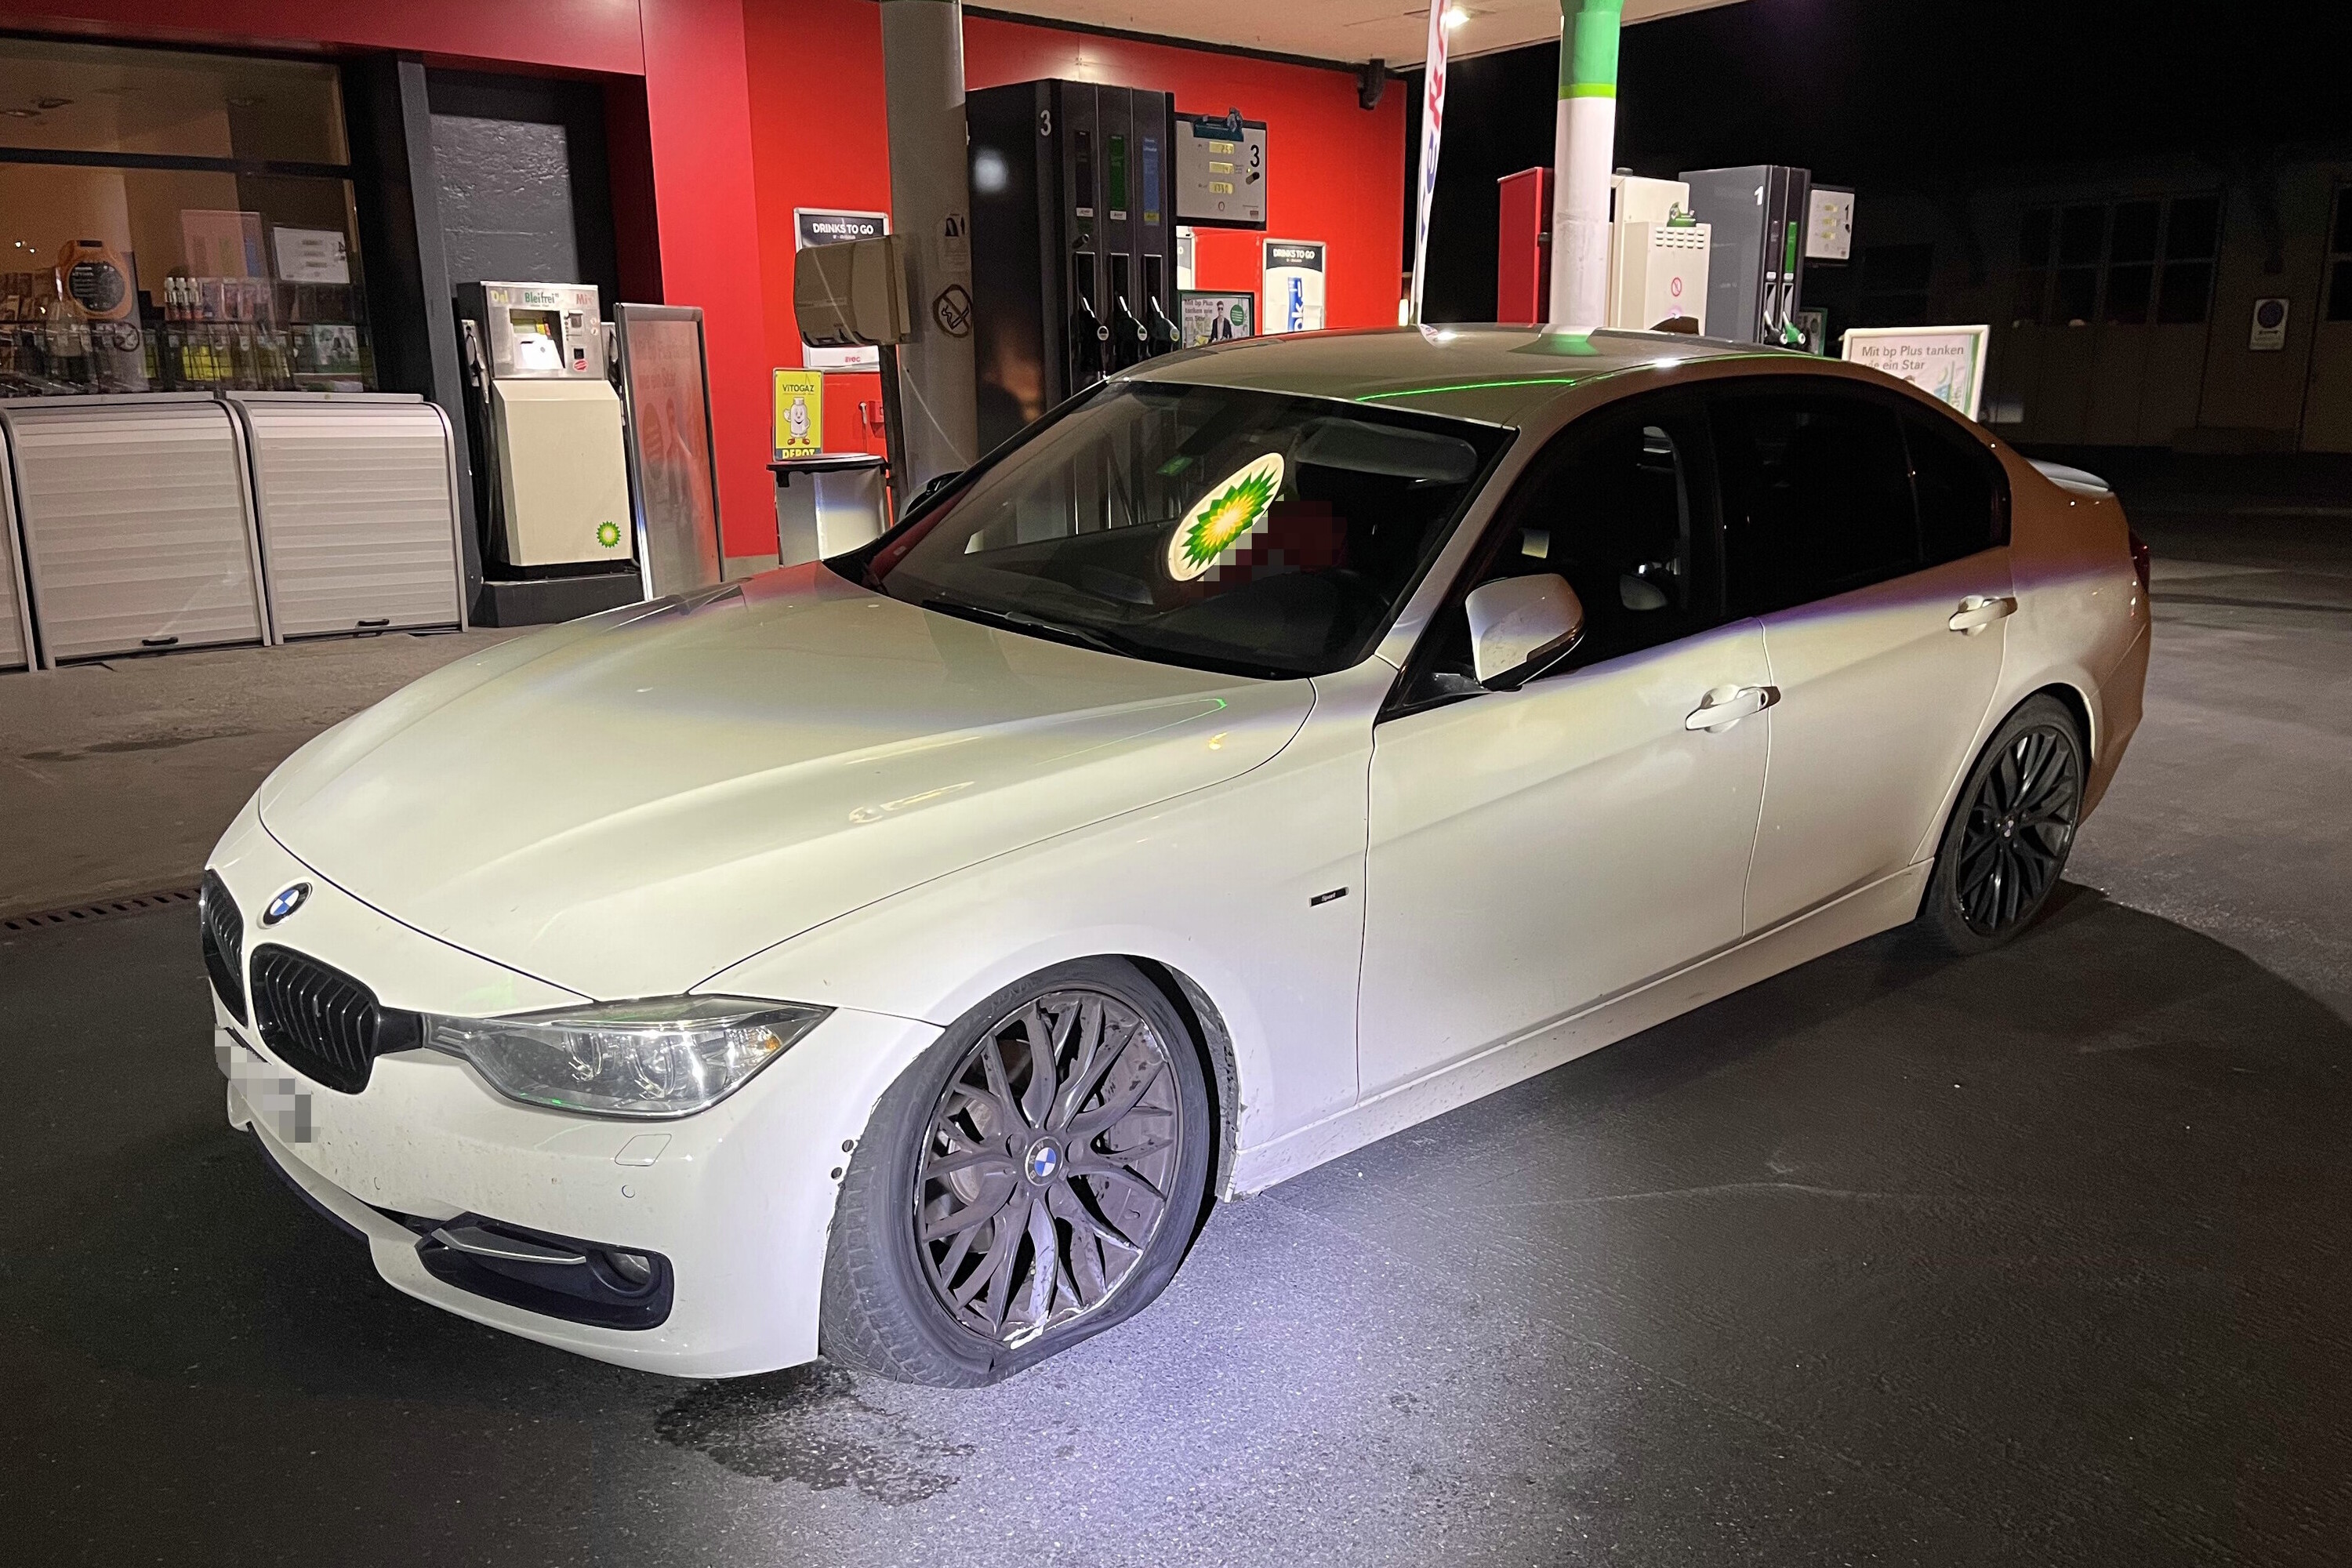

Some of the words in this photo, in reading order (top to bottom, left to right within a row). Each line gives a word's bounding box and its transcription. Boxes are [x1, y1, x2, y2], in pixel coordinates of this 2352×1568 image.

[1040, 110, 1052, 136] 3
[1250, 144, 1260, 168] 3
[1754, 186, 1764, 206] 1
[812, 223, 846, 234] DRINKS
[846, 224, 858, 234] TO
[859, 224, 874, 234] GO
[1272, 249, 1296, 258] DRINKS
[1296, 249, 1305, 259] TO
[1305, 250, 1316, 260] GO
[524, 292, 554, 303] Bleifrei
[1862, 346, 1879, 357] Mit
[1882, 346, 1896, 358] bp
[1900, 345, 1922, 356] Plus
[1926, 344, 1964, 356] tanken
[1882, 360, 1898, 370] ein
[1902, 359, 1925, 370] Star
